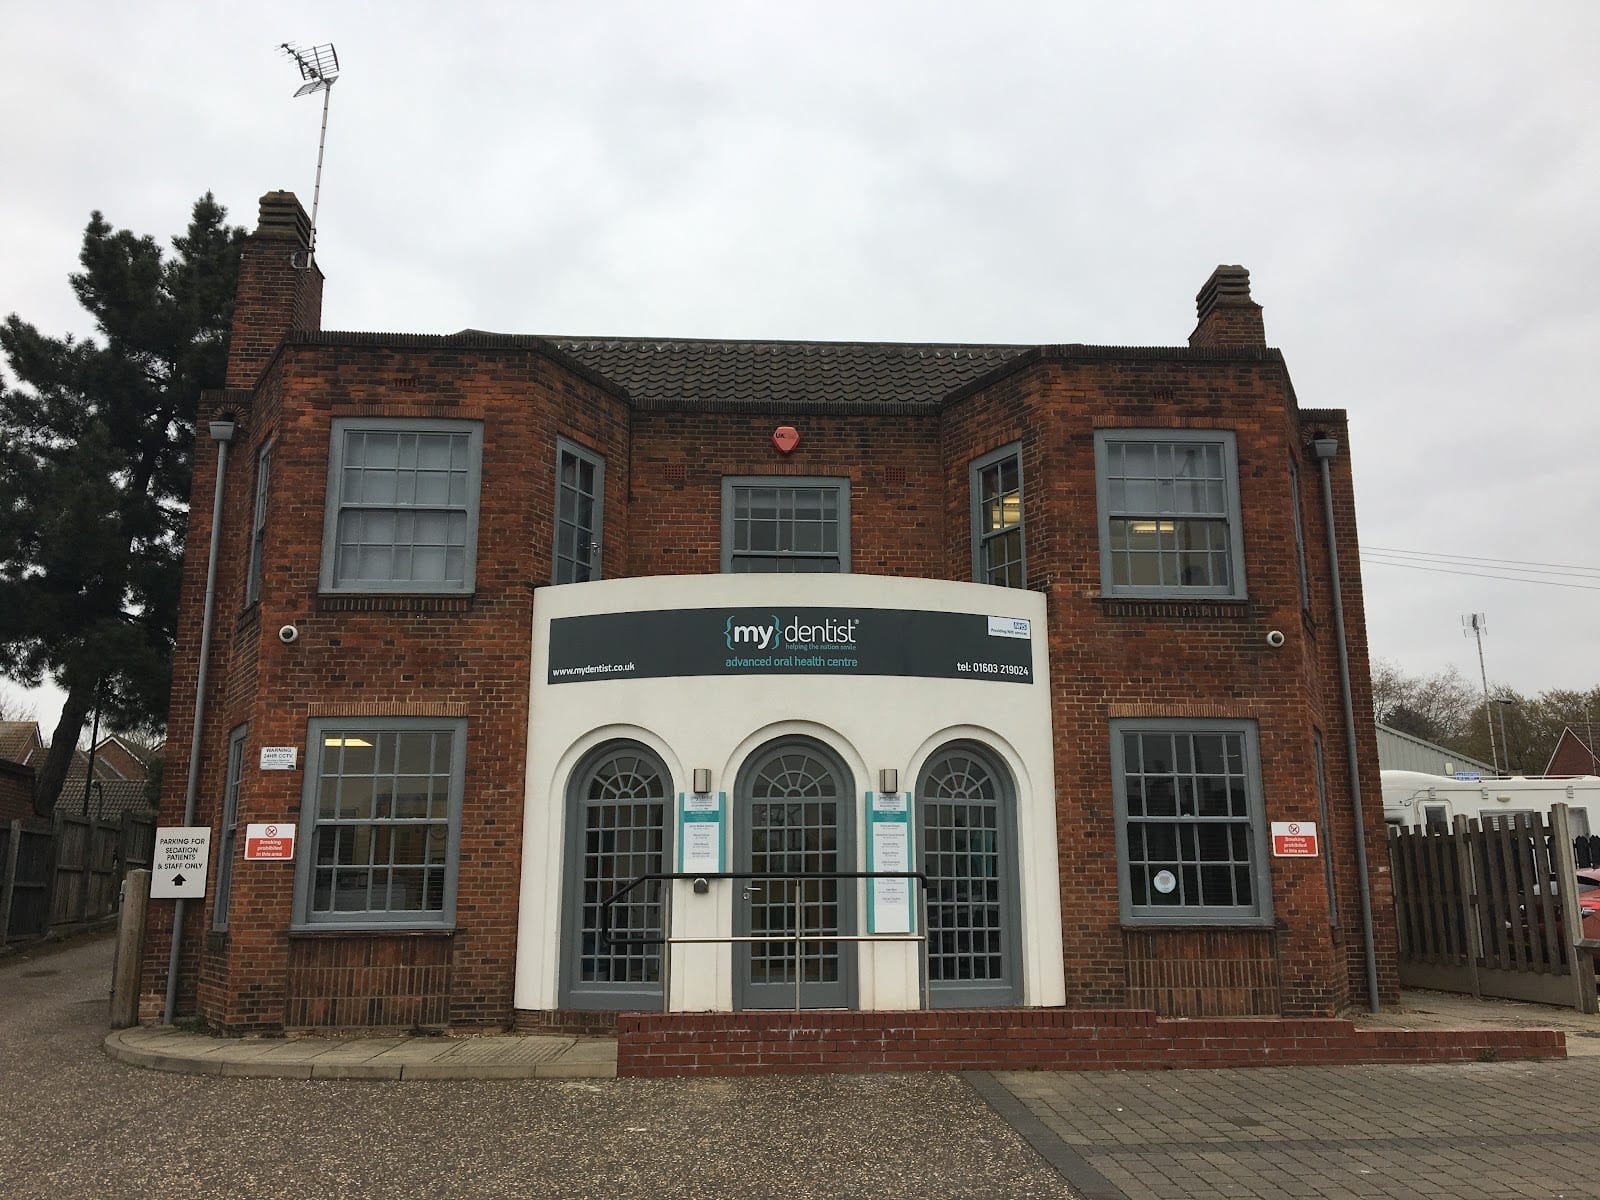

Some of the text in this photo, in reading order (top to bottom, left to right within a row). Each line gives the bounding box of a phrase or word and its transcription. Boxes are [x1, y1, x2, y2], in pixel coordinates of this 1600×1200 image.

[785, 643, 808, 651] helping
[725, 656, 858, 667] advanced oral health centre
[552, 662, 635, 676] www.mydentist.co.uk
[957, 662, 1028, 675] tel: 01603 219024
[184, 862, 203, 870] ONLY
